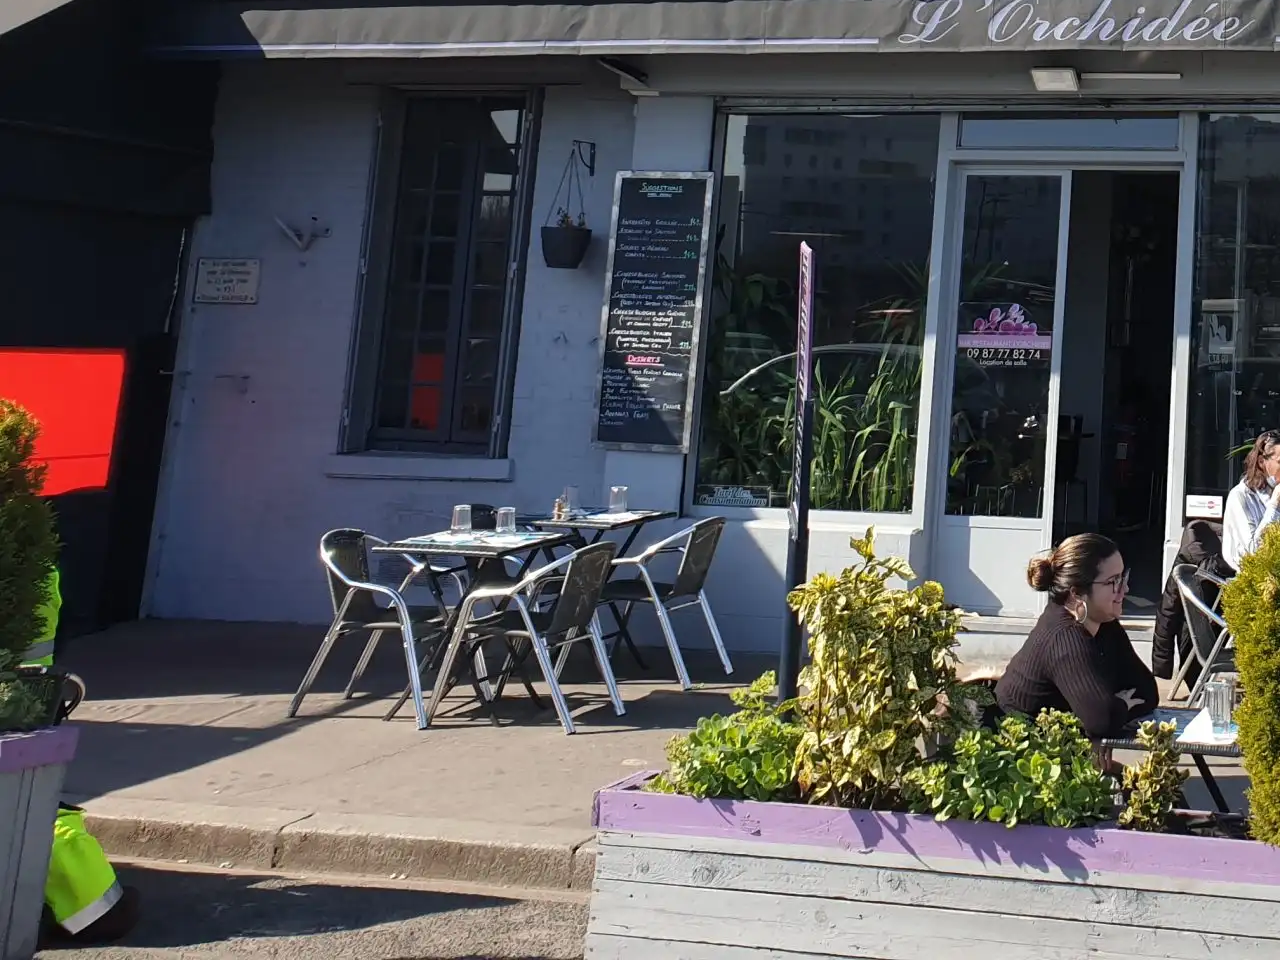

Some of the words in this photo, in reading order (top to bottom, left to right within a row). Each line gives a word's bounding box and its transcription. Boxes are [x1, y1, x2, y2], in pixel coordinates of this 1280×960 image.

[967, 348, 979, 358] 09
[982, 349, 994, 358] 87
[998, 349, 1010, 359] 77
[1012, 349, 1025, 359] 82
[1028, 350, 1040, 359] 74
